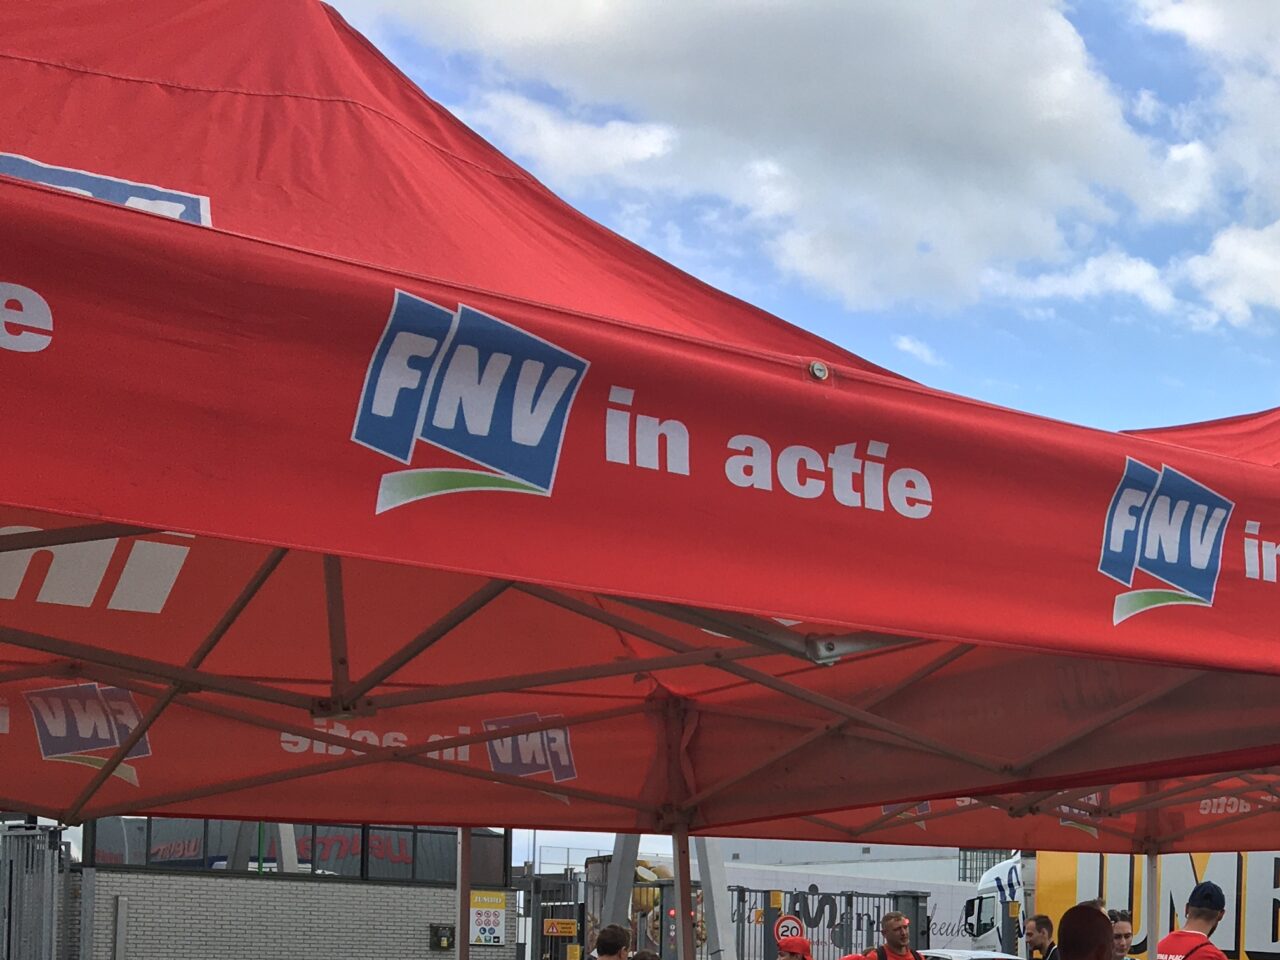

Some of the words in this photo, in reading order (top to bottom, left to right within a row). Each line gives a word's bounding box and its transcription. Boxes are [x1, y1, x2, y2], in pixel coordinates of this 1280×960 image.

[371, 332, 576, 447] FNV
[605, 385, 690, 476] in
[724, 434, 933, 519] actie
[1109, 489, 1226, 570] FNV
[780, 925, 799, 937] 20
